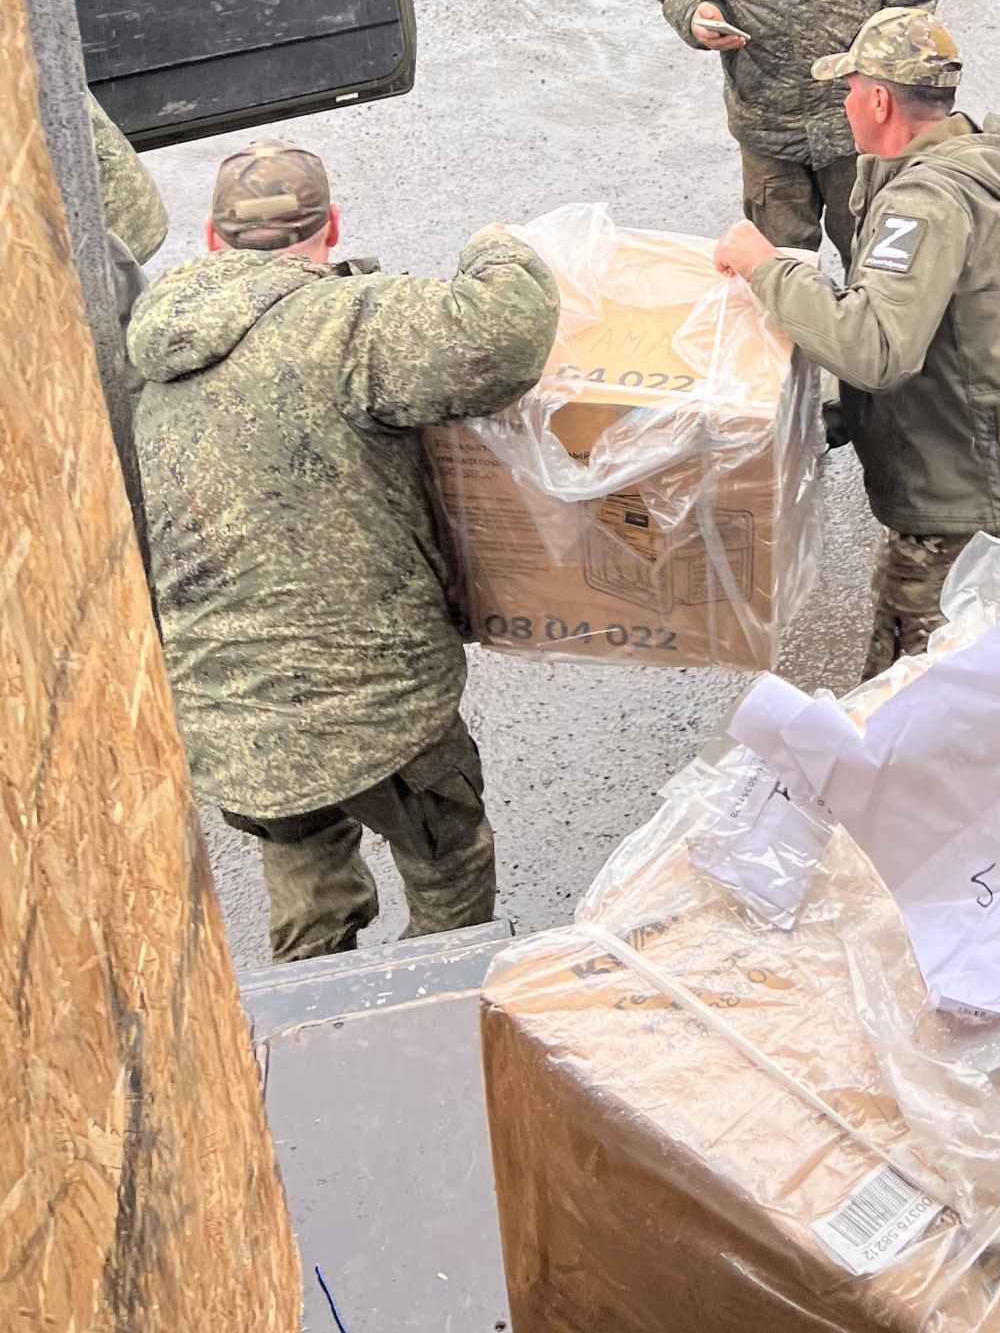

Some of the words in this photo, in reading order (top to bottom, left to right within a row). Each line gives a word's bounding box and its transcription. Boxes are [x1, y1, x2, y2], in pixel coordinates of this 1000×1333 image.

[872, 218, 918, 259] Z
[619, 371, 695, 393] 022
[485, 614, 534, 641] 08
[545, 616, 594, 645] 04
[605, 622, 678, 651] 022
[898, 1197, 934, 1233] 00375
[861, 1229, 900, 1262] 58212
